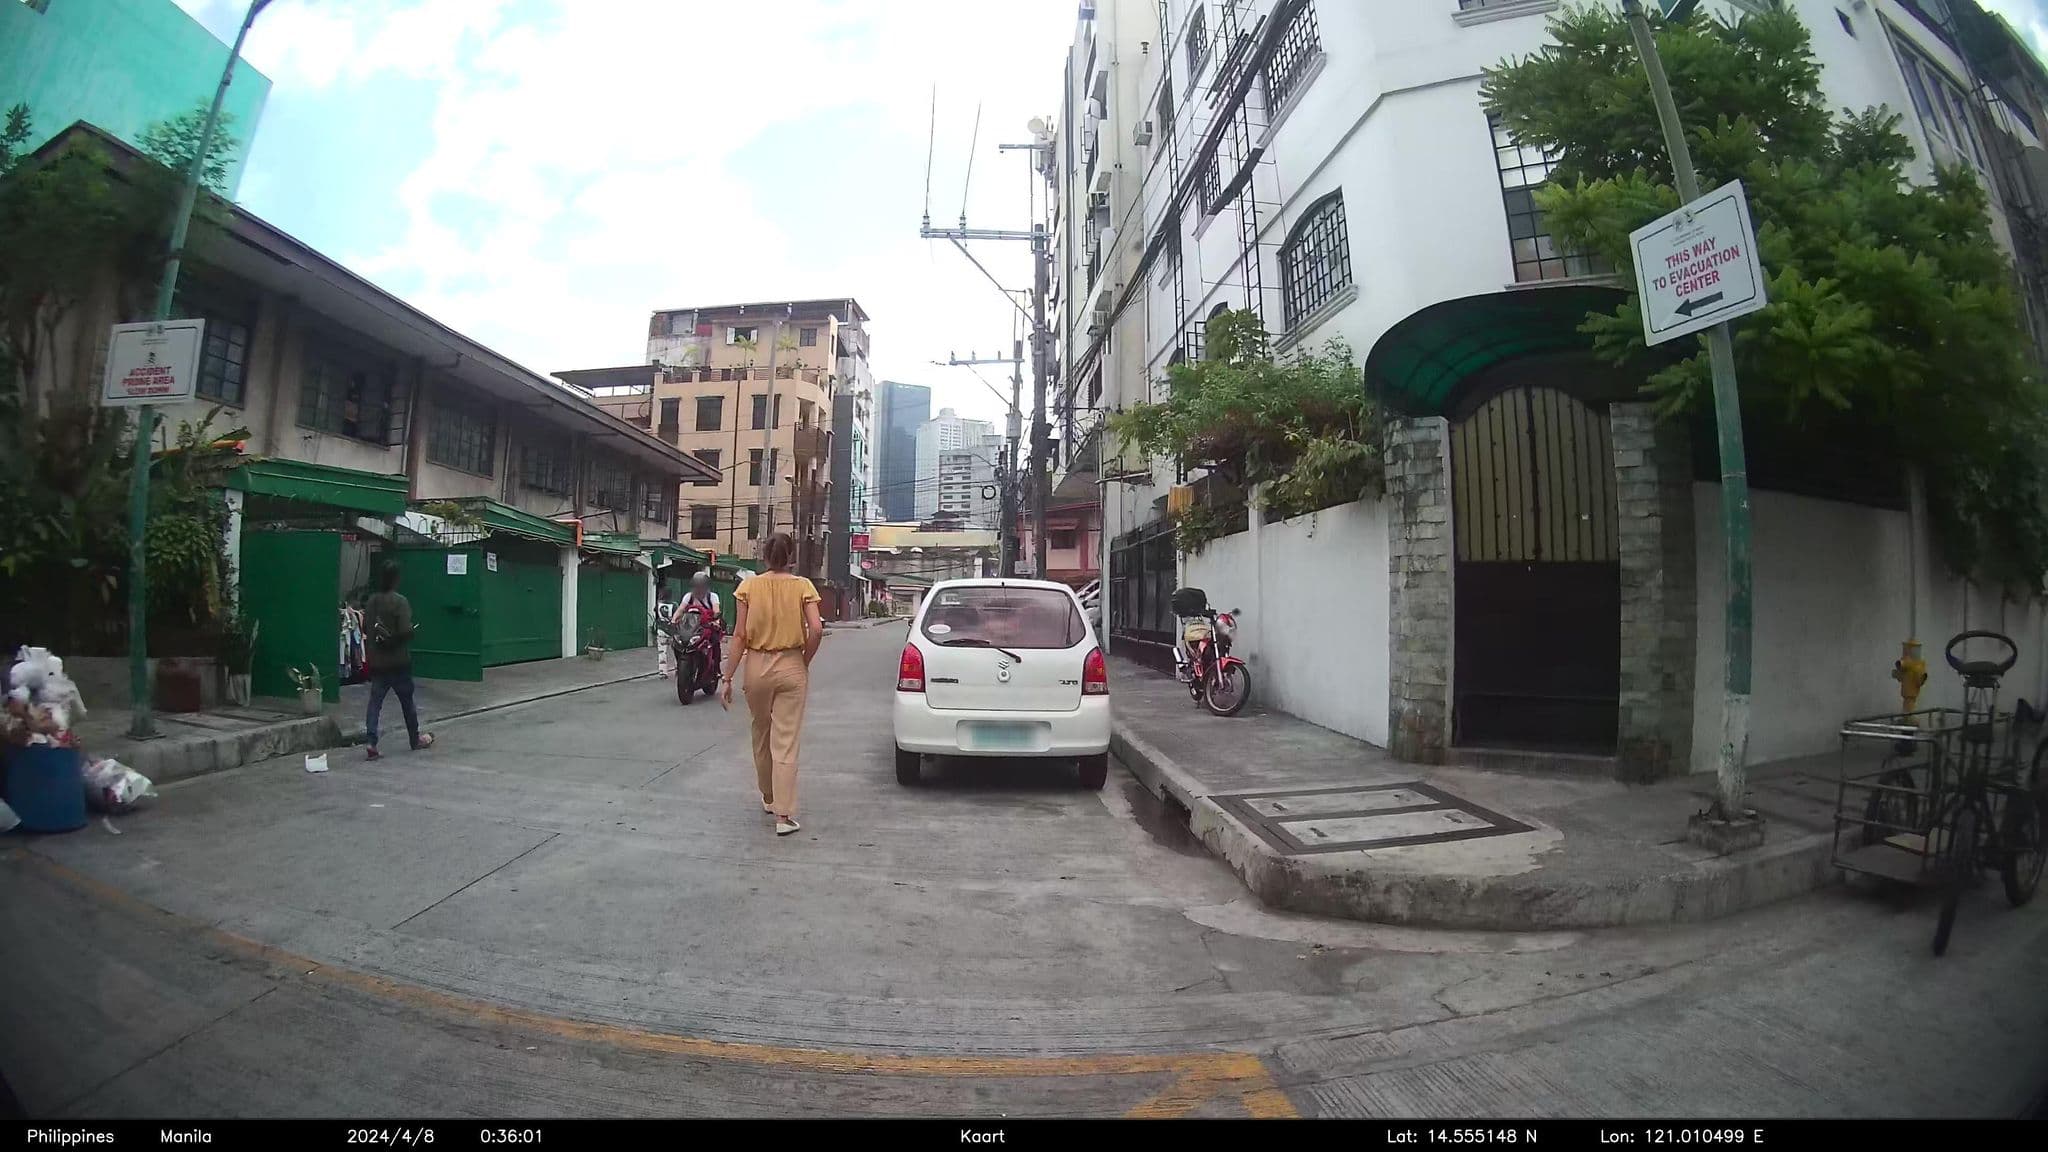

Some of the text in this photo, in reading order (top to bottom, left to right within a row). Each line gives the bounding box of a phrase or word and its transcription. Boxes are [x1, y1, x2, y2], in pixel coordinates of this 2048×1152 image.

[1665, 237, 1717, 269] THIS WAY
[1653, 245, 1740, 291] TO EVACUATION
[1675, 270, 1721, 297] CENTER
[129, 366, 172, 377] ACCIDENT
[152, 376, 175, 385] AREA
